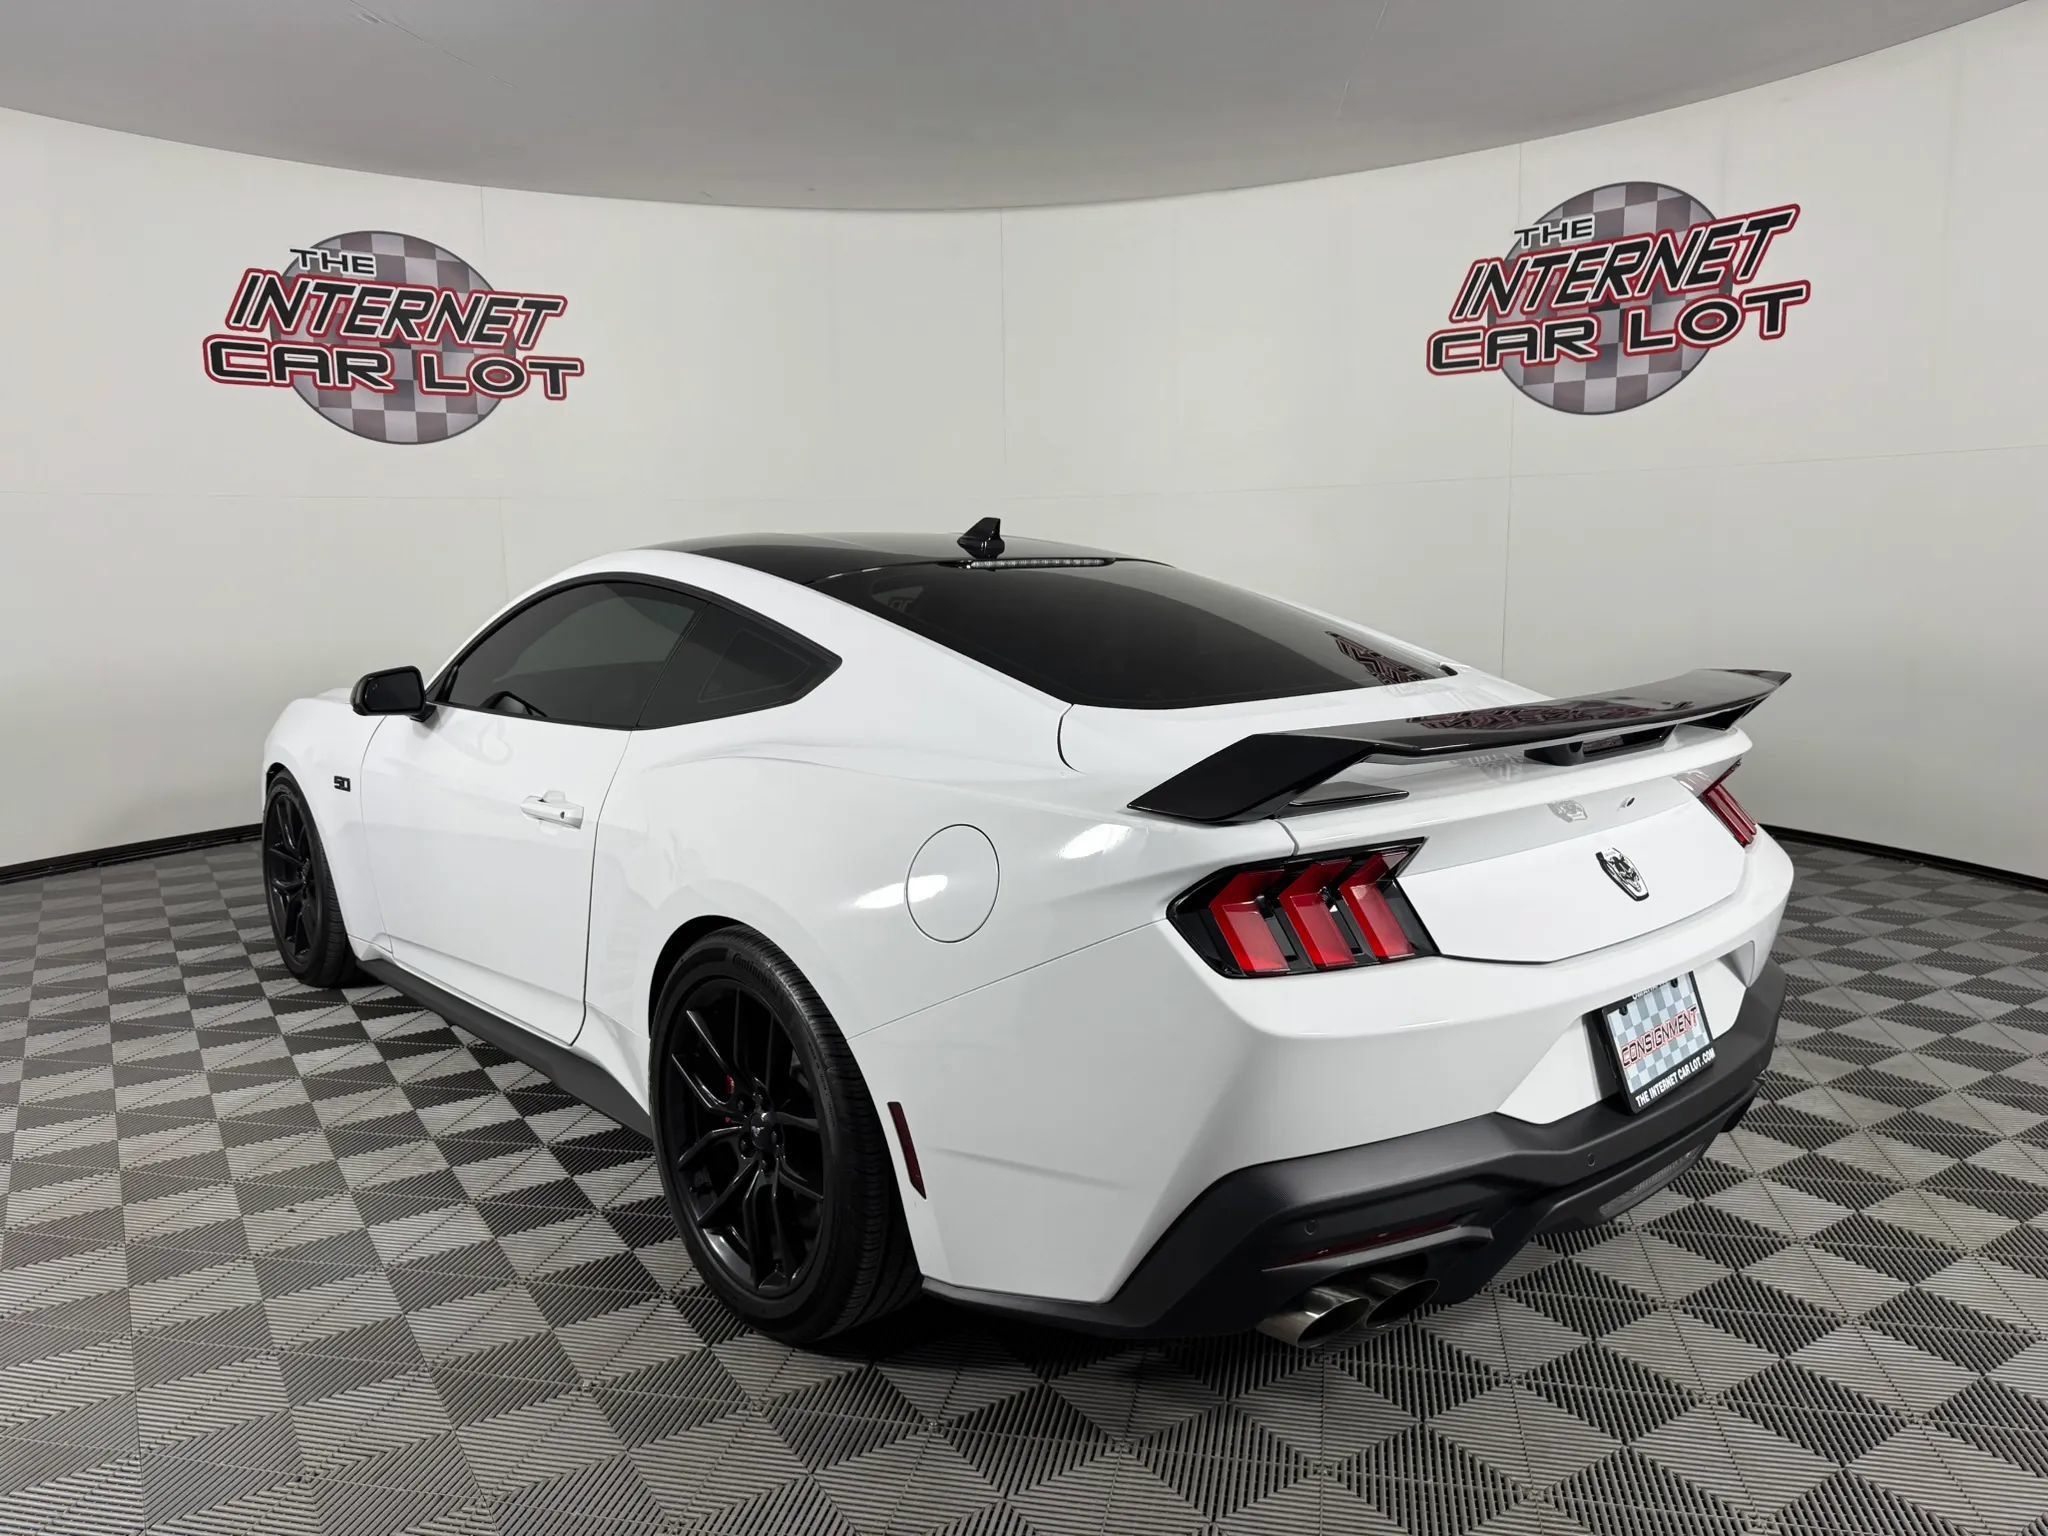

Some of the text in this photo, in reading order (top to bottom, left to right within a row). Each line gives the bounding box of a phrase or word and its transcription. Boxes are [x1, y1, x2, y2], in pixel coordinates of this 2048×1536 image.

[289, 247, 378, 277] THE
[1514, 215, 1595, 248] THE
[1452, 206, 1798, 321] INTERNET
[229, 270, 566, 348] INTERNET
[1430, 283, 1808, 372] CAR LOT
[206, 338, 583, 399] CAR LOT
[1620, 1005, 1699, 1067] CONSIGNMENT
[1635, 1090, 1651, 1107] THE
[1648, 1071, 1679, 1099] INTERNET
[1677, 1064, 1692, 1080] CAR
